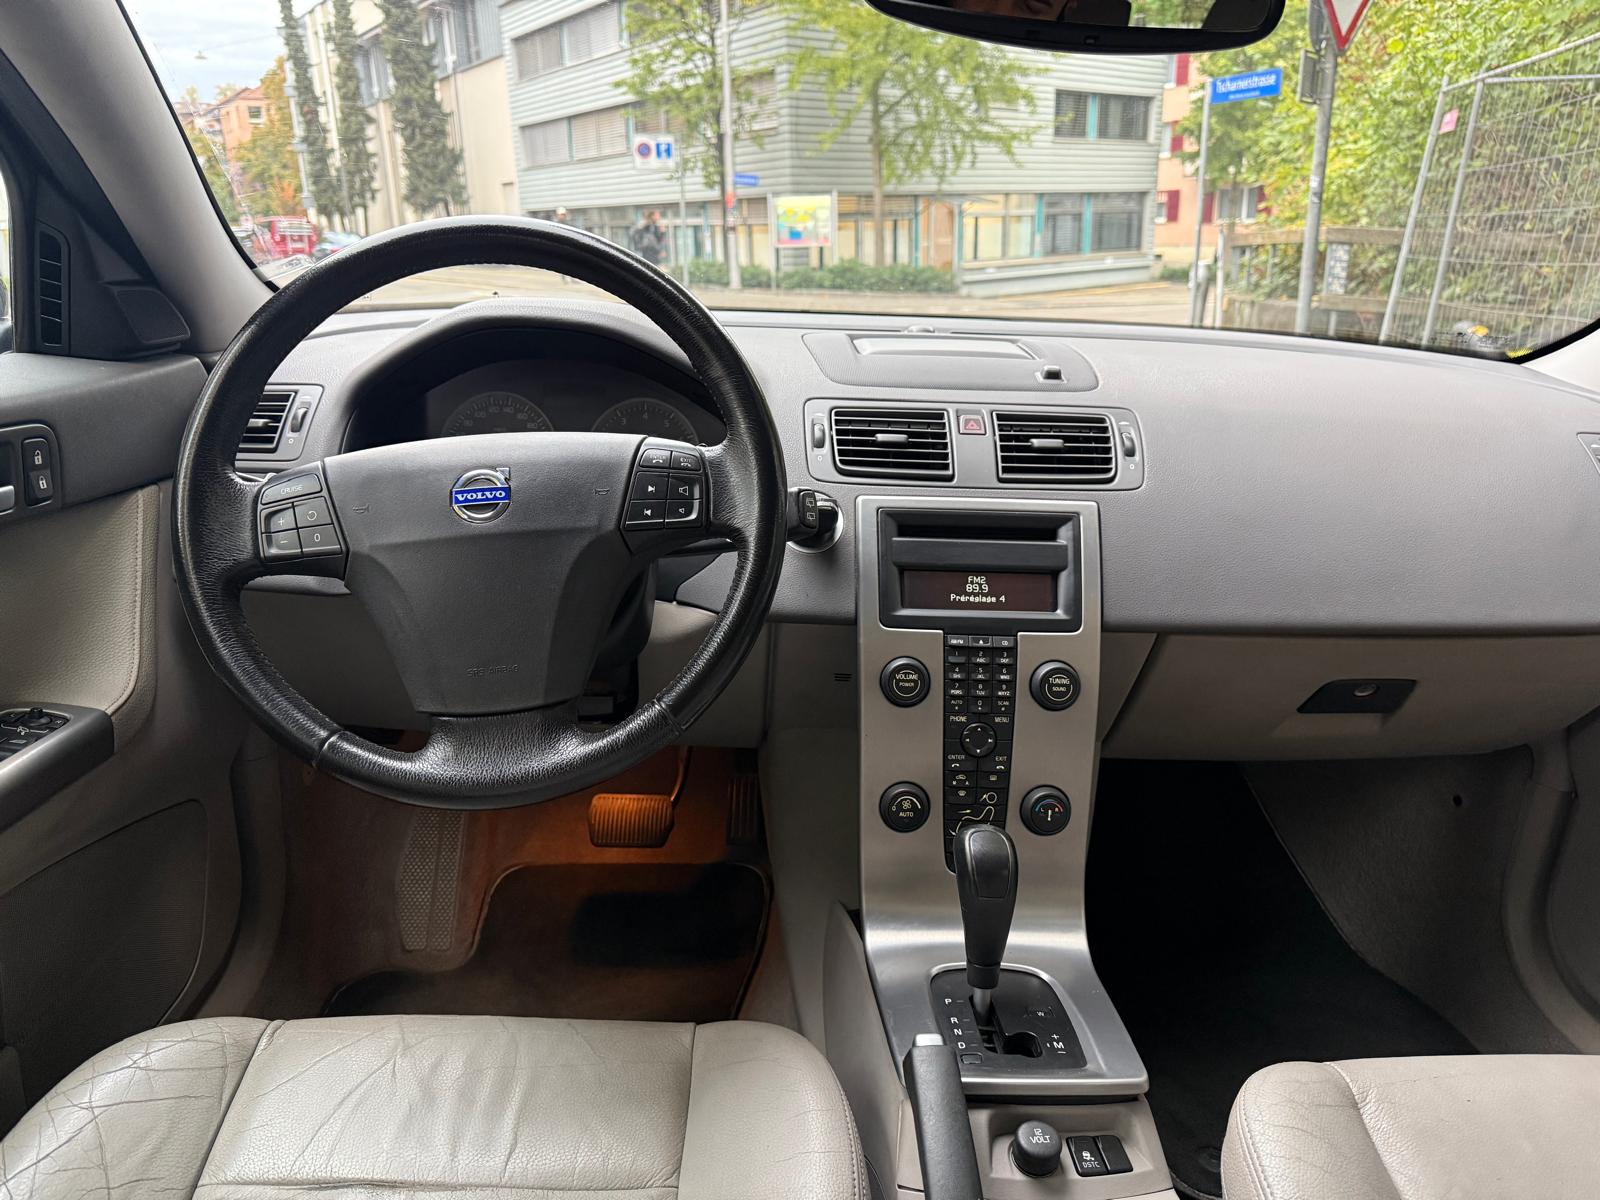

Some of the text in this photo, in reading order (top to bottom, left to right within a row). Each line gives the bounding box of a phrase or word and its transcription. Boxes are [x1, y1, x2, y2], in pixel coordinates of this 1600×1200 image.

[280, 484, 304, 495] CRUISE
[455, 490, 506, 501] VOLVO
[967, 575, 987, 584] FM2
[965, 583, 989, 593] 89.9
[950, 593, 1006, 603] Préréglage 4
[1049, 677, 1070, 685] TUNING
[950, 1016, 959, 1024] R
[957, 1041, 966, 1049] D
[1033, 1128, 1042, 1136] 12
[1029, 1135, 1051, 1144] VOLT
